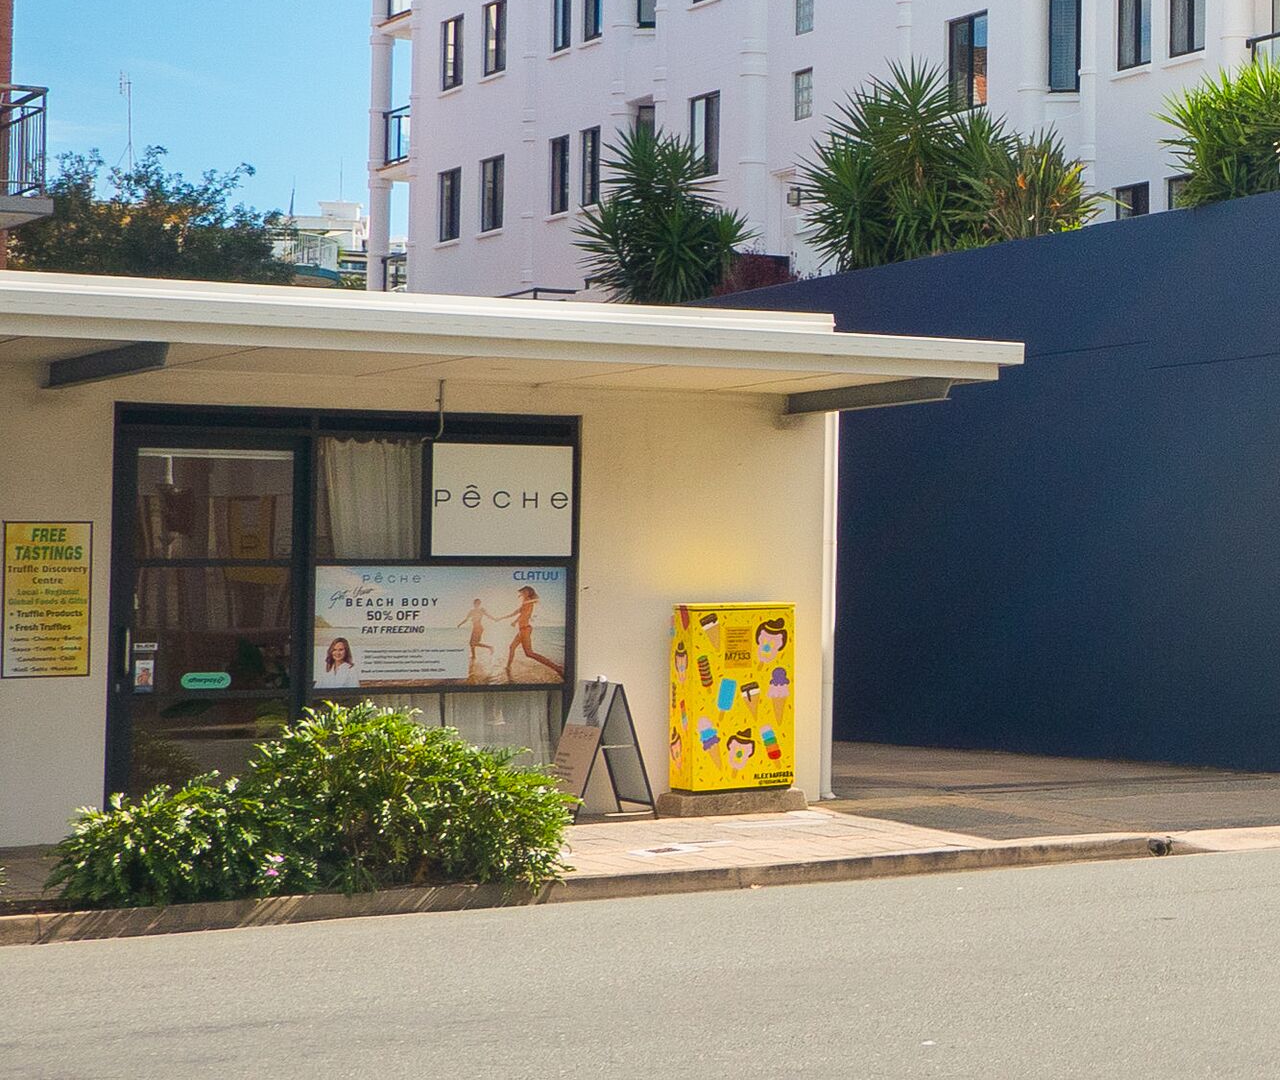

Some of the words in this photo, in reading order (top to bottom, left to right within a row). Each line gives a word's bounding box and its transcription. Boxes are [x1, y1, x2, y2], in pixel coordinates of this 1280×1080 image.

[32, 527, 67, 542] FREE
[15, 545, 83, 560] TASTINGS
[8, 565, 39, 573] Truffle
[42, 565, 88, 575] Discovery
[32, 576, 64, 585] Centre
[513, 571, 559, 581] CLATUU
[346, 598, 394, 607] BEACH
[401, 597, 438, 607] BODY
[367, 610, 393, 621] 50%
[396, 610, 420, 621] OFF
[40, 623, 71, 631] Truffles
[361, 625, 379, 634] FAT
[380, 625, 425, 634] FREEZING
[724, 652, 751, 661] M7133
